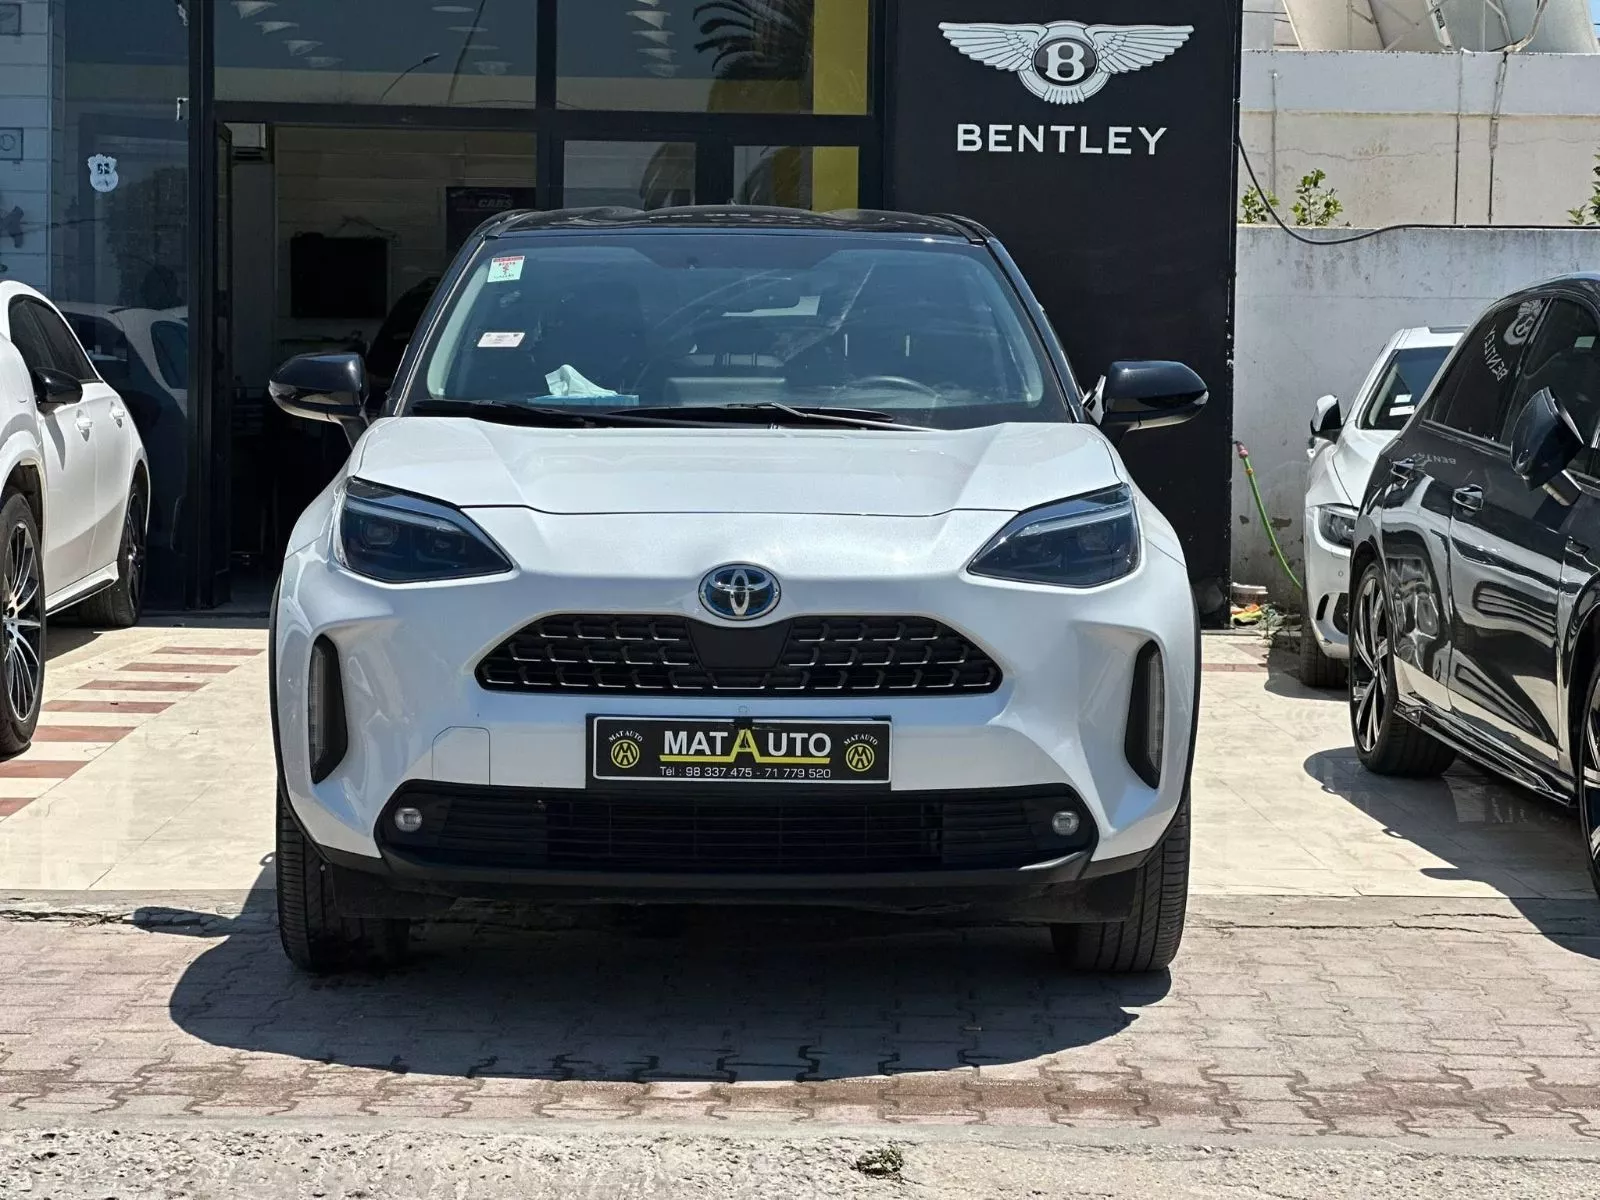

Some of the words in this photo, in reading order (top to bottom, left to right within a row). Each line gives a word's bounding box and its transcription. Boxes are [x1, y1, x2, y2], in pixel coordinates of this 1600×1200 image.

[1044, 41, 1085, 82] B
[957, 123, 1168, 156] BENTLEY
[478, 199, 513, 209] CARS
[609, 730, 624, 743] MAT
[624, 730, 643, 742] AUTO
[664, 730, 729, 756] MAT
[843, 734, 859, 746] MAT
[859, 733, 878, 746] AUTO
[659, 766, 675, 777] Tél
[685, 767, 701, 777] 98
[704, 767, 726, 778] 337
[729, 767, 753, 778] 475
[764, 768, 779, 778] 71
[783, 769, 805, 779] 779
[808, 769, 832, 779] 520
